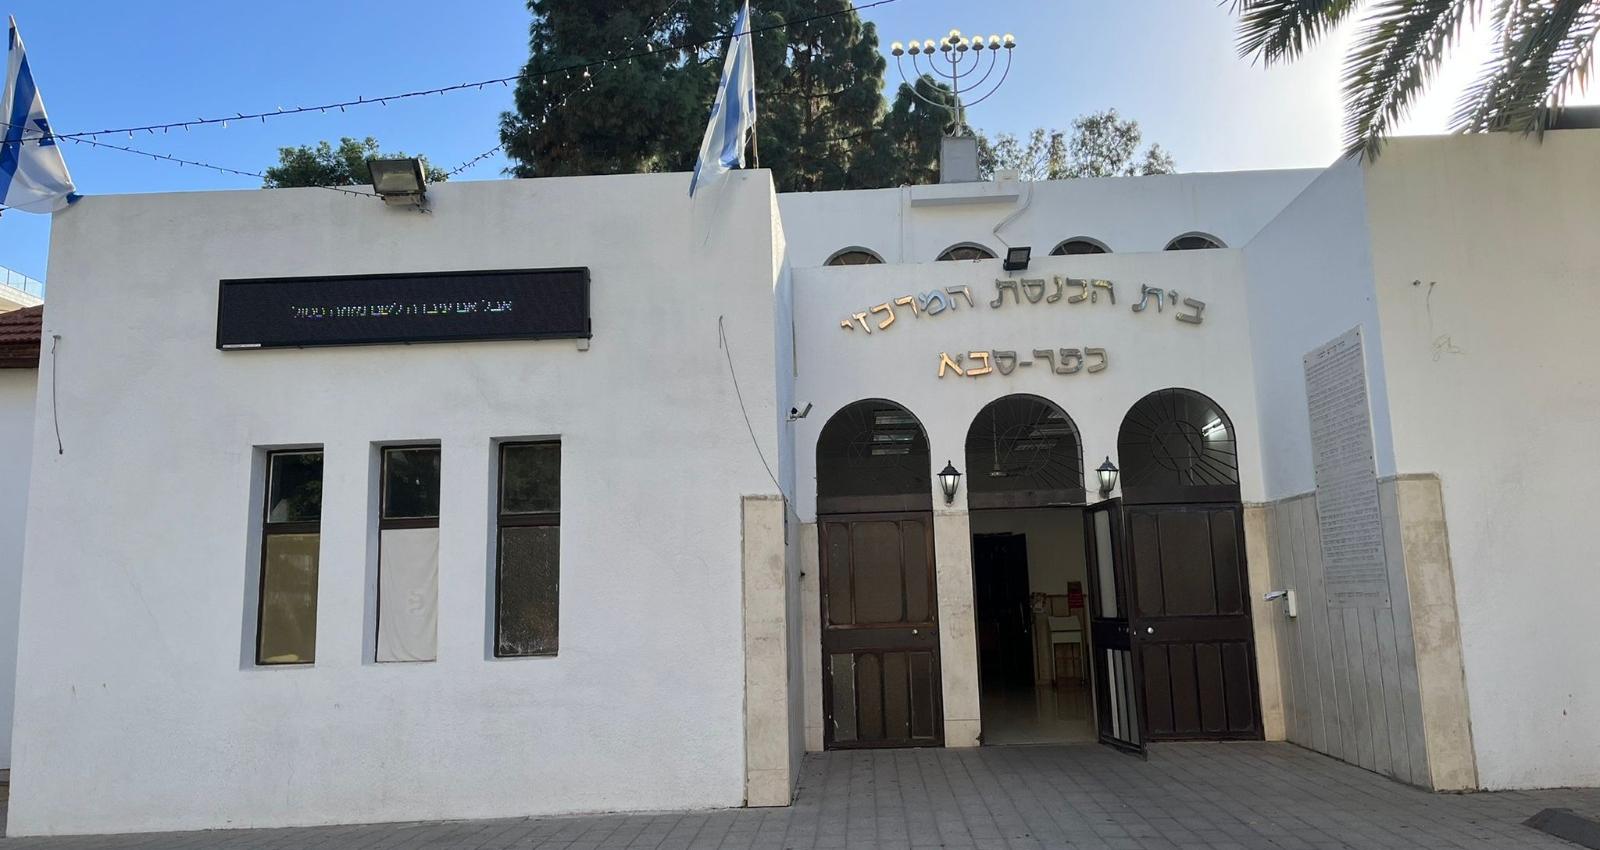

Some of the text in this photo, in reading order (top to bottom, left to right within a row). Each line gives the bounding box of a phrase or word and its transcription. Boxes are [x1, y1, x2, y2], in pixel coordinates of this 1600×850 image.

[456, 302, 477, 314] אם
[481, 299, 512, 312] אבל
[840, 276, 1206, 334] בית הכנסת המרכזי
[938, 346, 1109, 377] כפר-סבא
